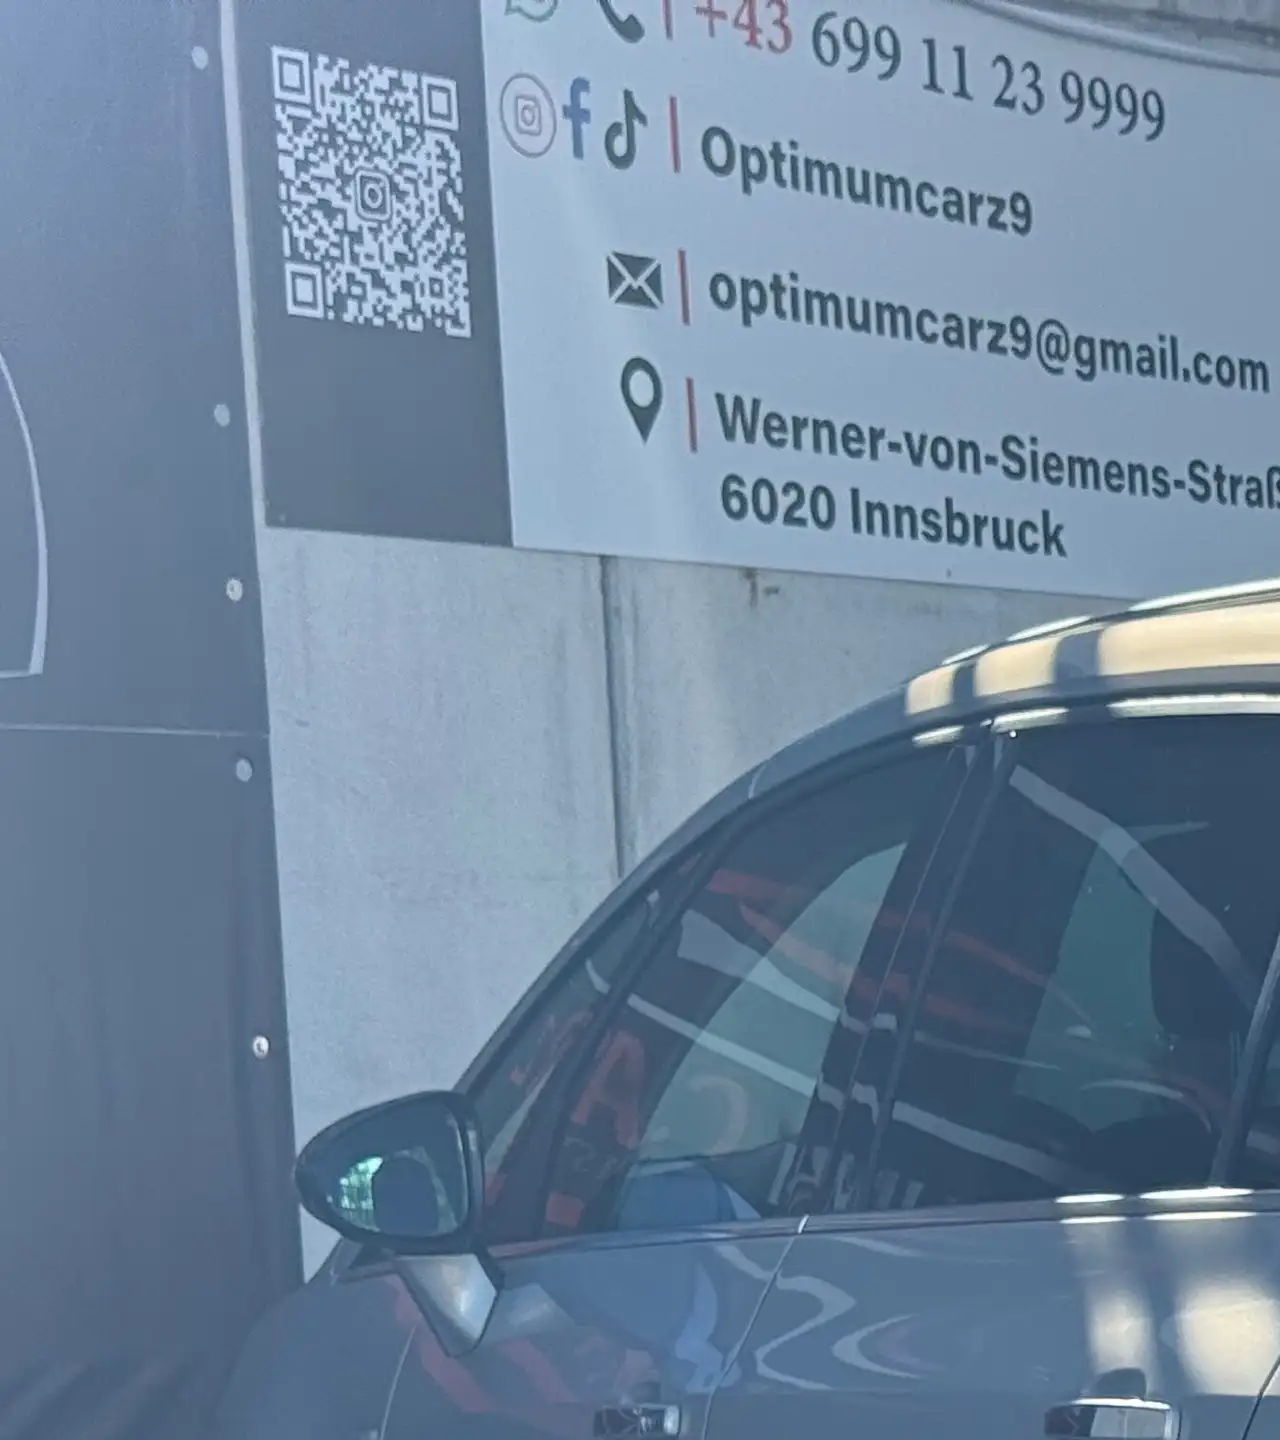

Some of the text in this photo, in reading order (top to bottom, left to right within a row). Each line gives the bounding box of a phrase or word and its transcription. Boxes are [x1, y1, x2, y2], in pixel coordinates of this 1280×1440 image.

[695, 0, 1166, 142] +43 699 11 23 9999
[701, 126, 1033, 236] Optimumcarz9
[708, 271, 1271, 393] optimumcarz9@gmail.com
[720, 473, 1068, 558] 6020 Innsbruck
